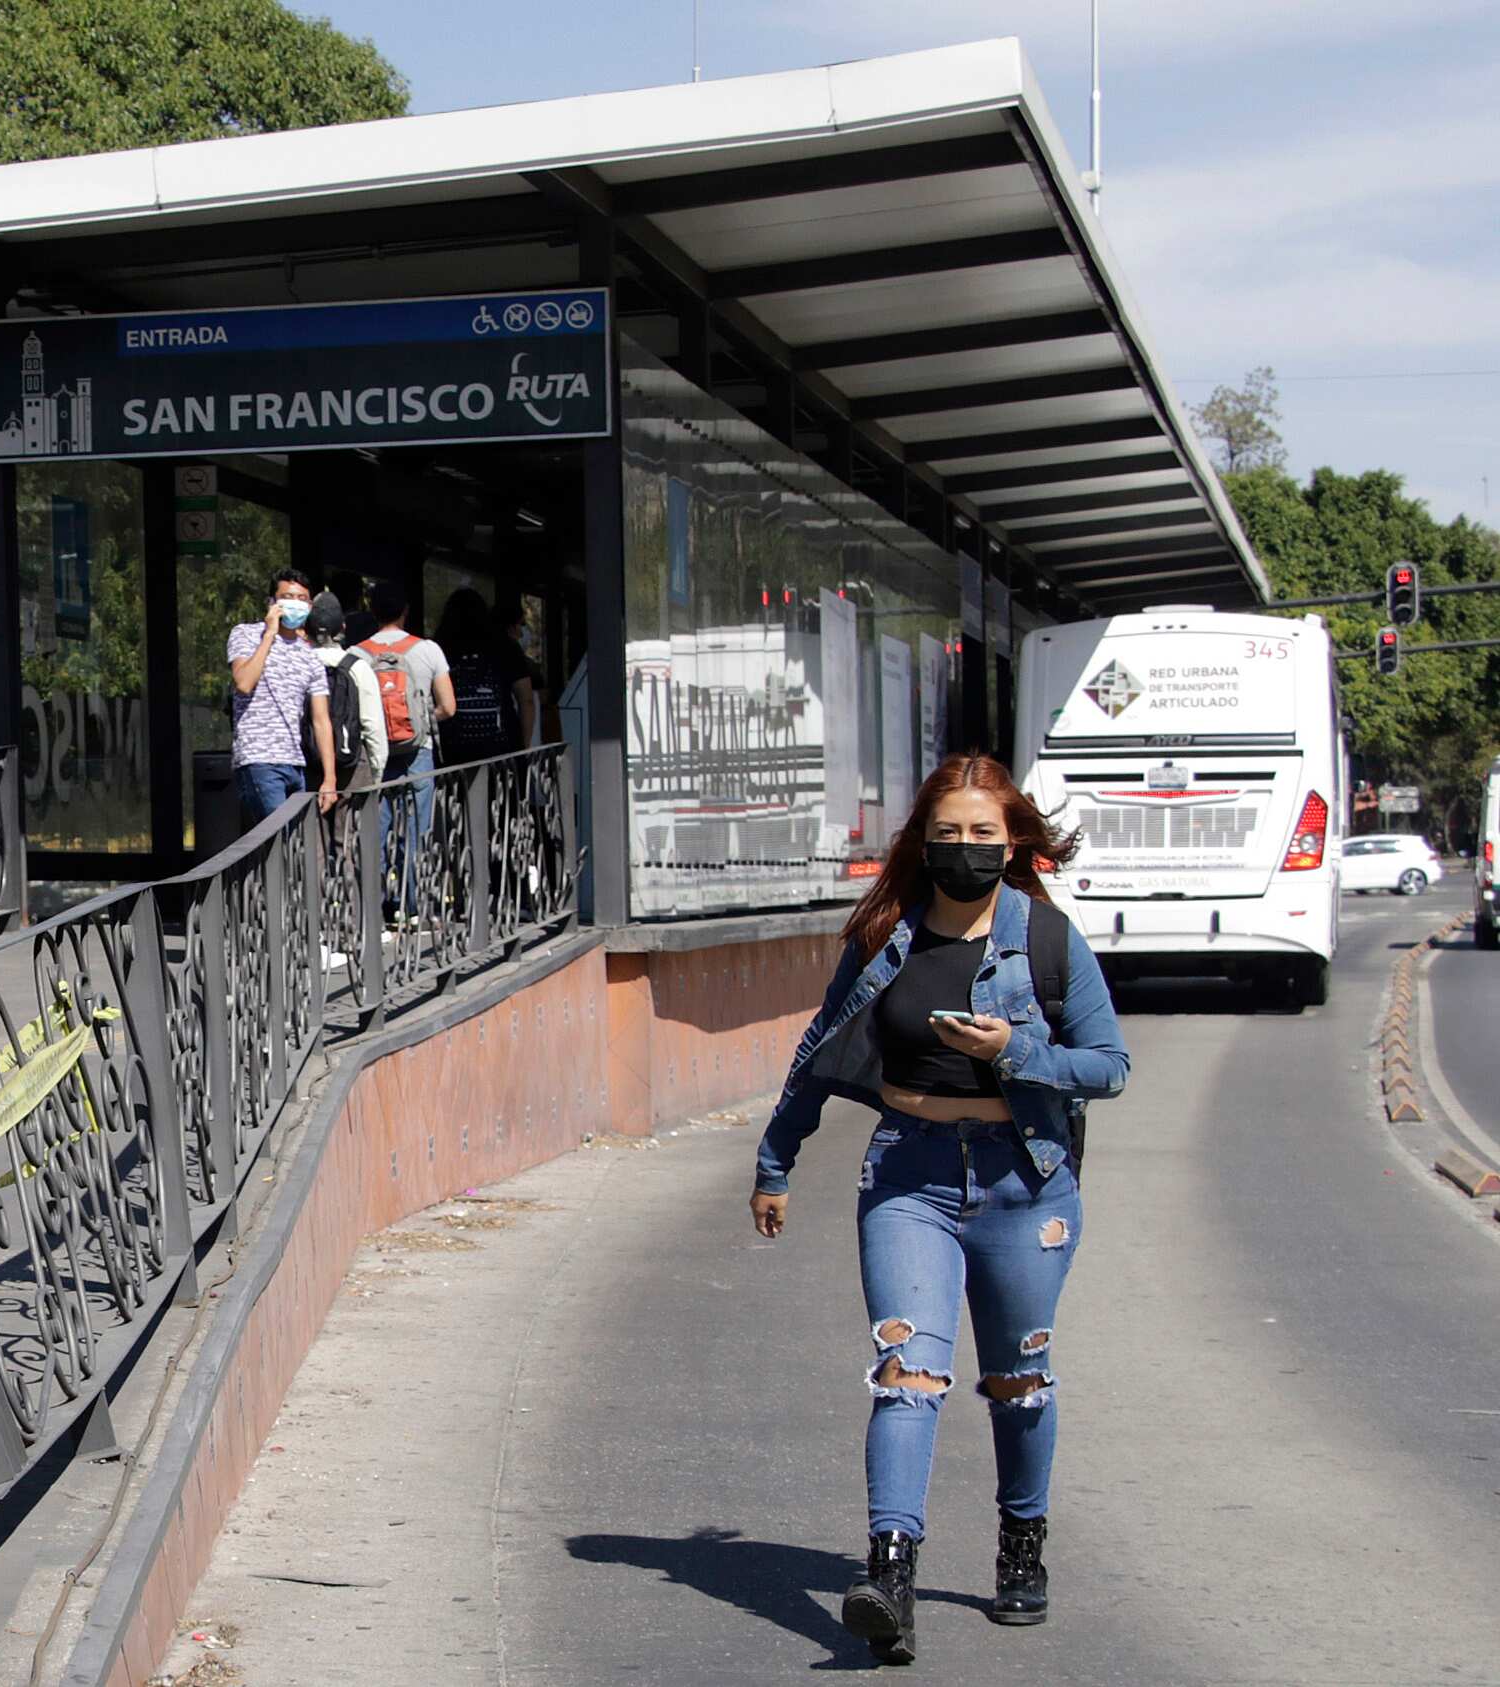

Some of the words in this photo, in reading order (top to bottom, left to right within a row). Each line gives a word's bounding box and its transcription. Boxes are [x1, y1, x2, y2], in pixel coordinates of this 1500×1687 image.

[126, 326, 228, 348] ENTRADA
[506, 372, 590, 401] RUTA
[123, 396, 215, 435] SAN
[229, 380, 494, 431] FRANCISCO
[1244, 638, 1288, 660] 345
[1149, 668, 1176, 679] RED
[1181, 666, 1239, 678] URBANA
[1149, 683, 1163, 692] DE
[1166, 681, 1239, 692] TRANSPORTE
[1149, 696, 1239, 709] ARTICULADO
